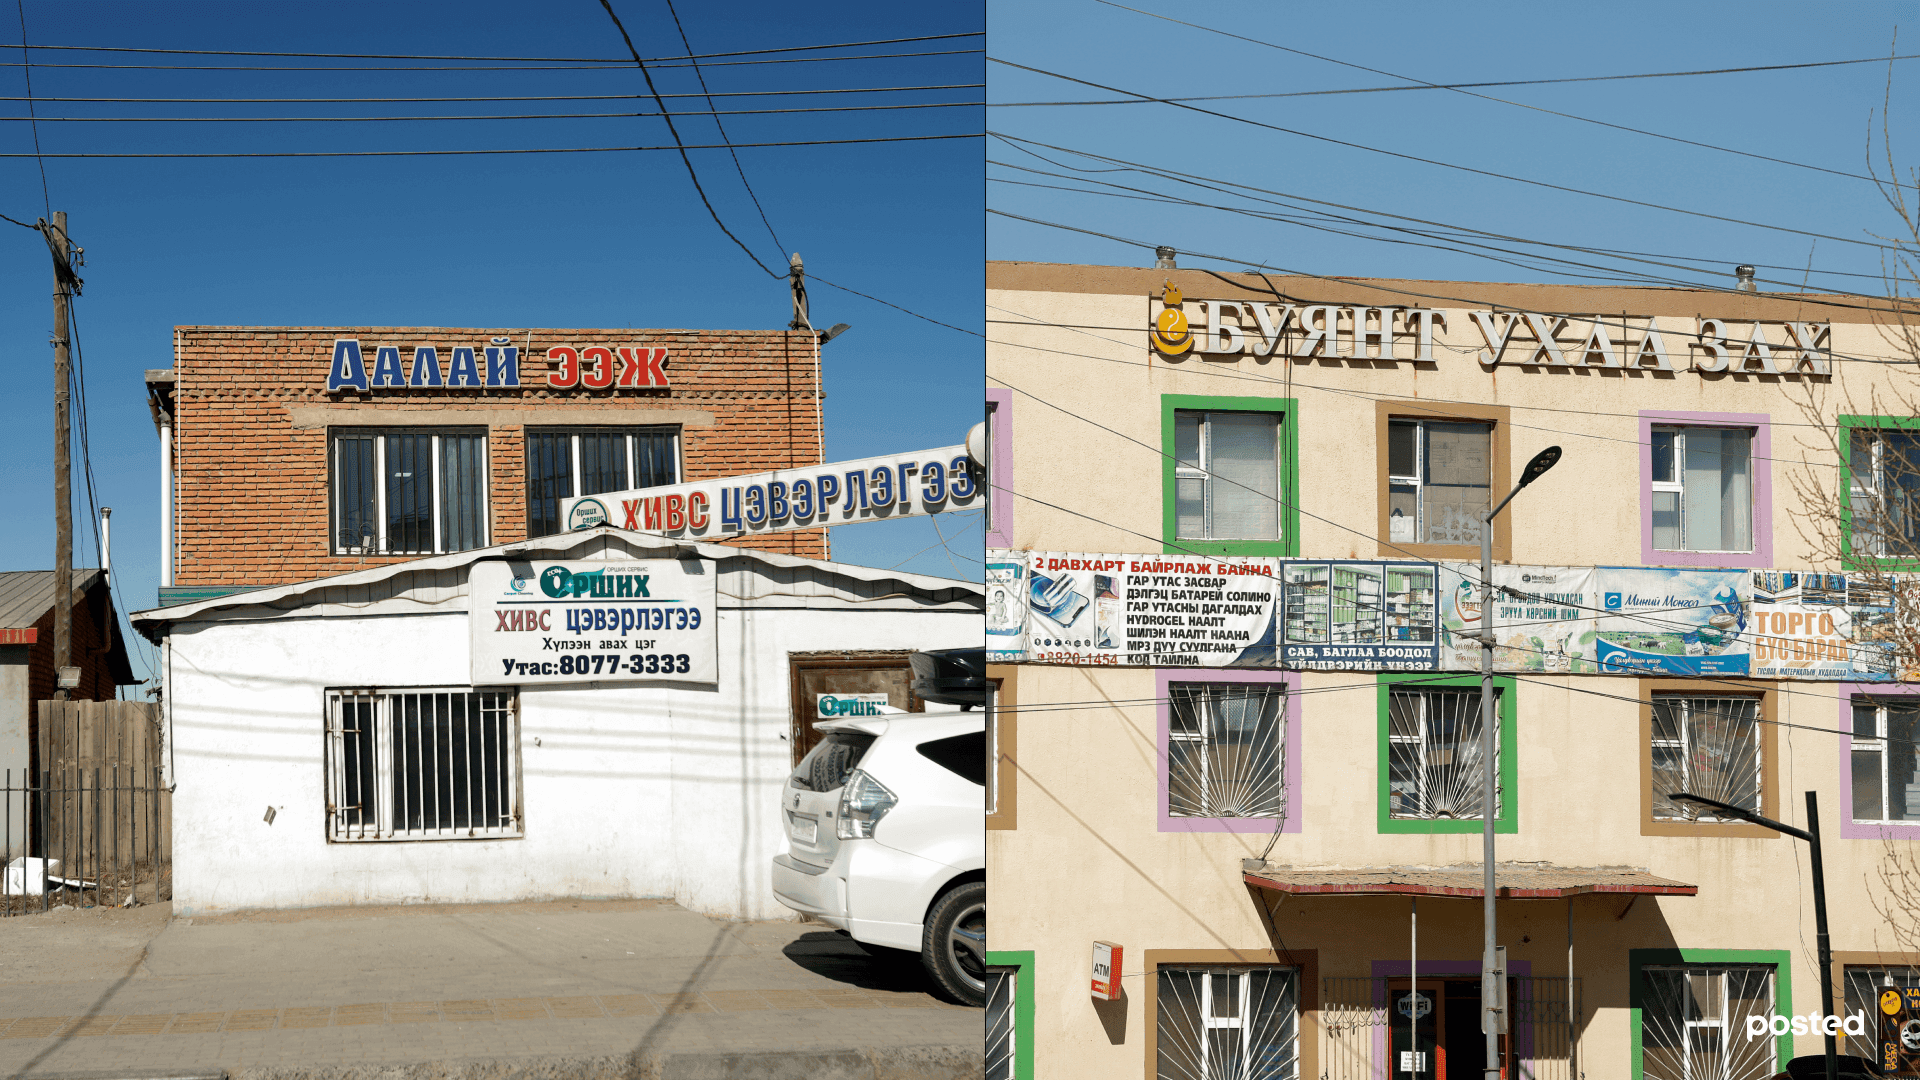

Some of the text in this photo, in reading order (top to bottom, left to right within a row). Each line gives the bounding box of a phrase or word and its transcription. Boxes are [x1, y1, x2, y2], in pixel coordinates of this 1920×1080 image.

[1201, 300, 1831, 375] БУЯНТ УХАА ЗАХ
[327, 337, 670, 393] ДАЛАЙ ЭЭЖ
[621, 455, 976, 532] ХИВС ЦЭВЭРЛЭГЭЭ
[1035, 557, 1272, 576] 2 ДАВХАРТ БАЙРЛАЖ БАЙНА
[1127, 575, 1226, 588] ГАР УТАС ЗАСВАР
[1127, 587, 1271, 602] ДЭЛГЭЦ БАТАРЕЙ СОЛИНО
[1625, 594, 1660, 607] Миний
[1127, 602, 1262, 615] ГАР УТАСНЫ ДАГАЛДАХ
[1561, 608, 1579, 620] ШИМ
[494, 608, 701, 636] ХИВС ЦЭВЭРЛЭГЭЭ
[1127, 615, 1225, 627] HYDROGEL НААЛТ
[1755, 611, 1834, 636] ТОРГО
[1127, 628, 1250, 641] ШИЛЭН НААЛТ НААНА
[542, 637, 656, 652] Хүлээн авах цэг
[1179, 642, 1237, 653] СУУЛГАНА
[1794, 638, 1849, 661] БАРАА
[1127, 653, 1199, 665] КОД ТАЙЛНА
[1287, 647, 1431, 658] САВ, БАГЛАА БООДОЛ
[1093, 963, 1109, 977] ATM
